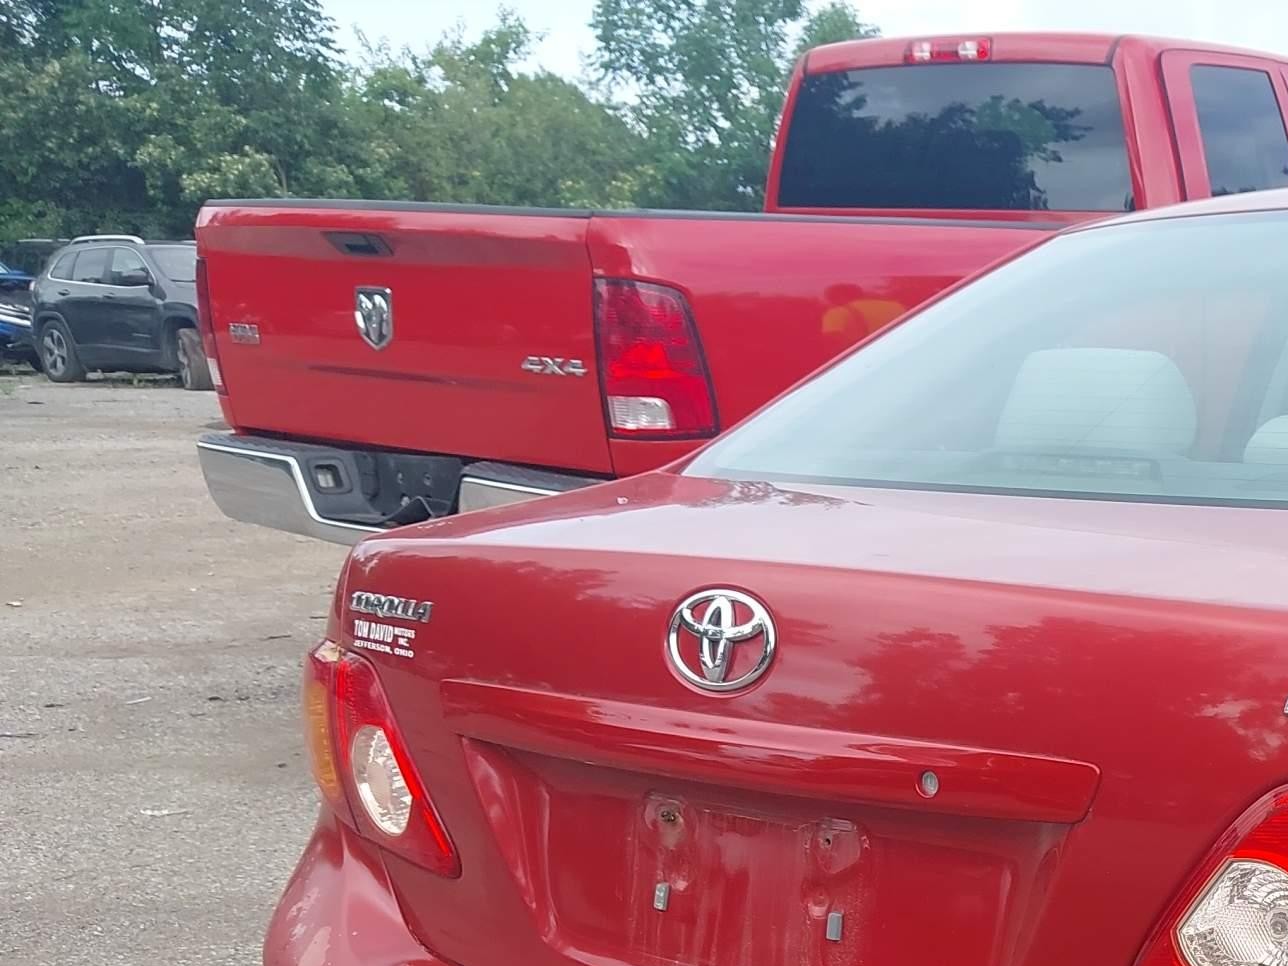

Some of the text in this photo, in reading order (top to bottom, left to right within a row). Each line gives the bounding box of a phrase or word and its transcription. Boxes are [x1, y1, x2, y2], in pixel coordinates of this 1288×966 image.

[521, 355, 588, 376] 4X4
[354, 620, 369, 638] TOM
[369, 622, 394, 642] DAVID
[394, 647, 414, 657] OHIO
